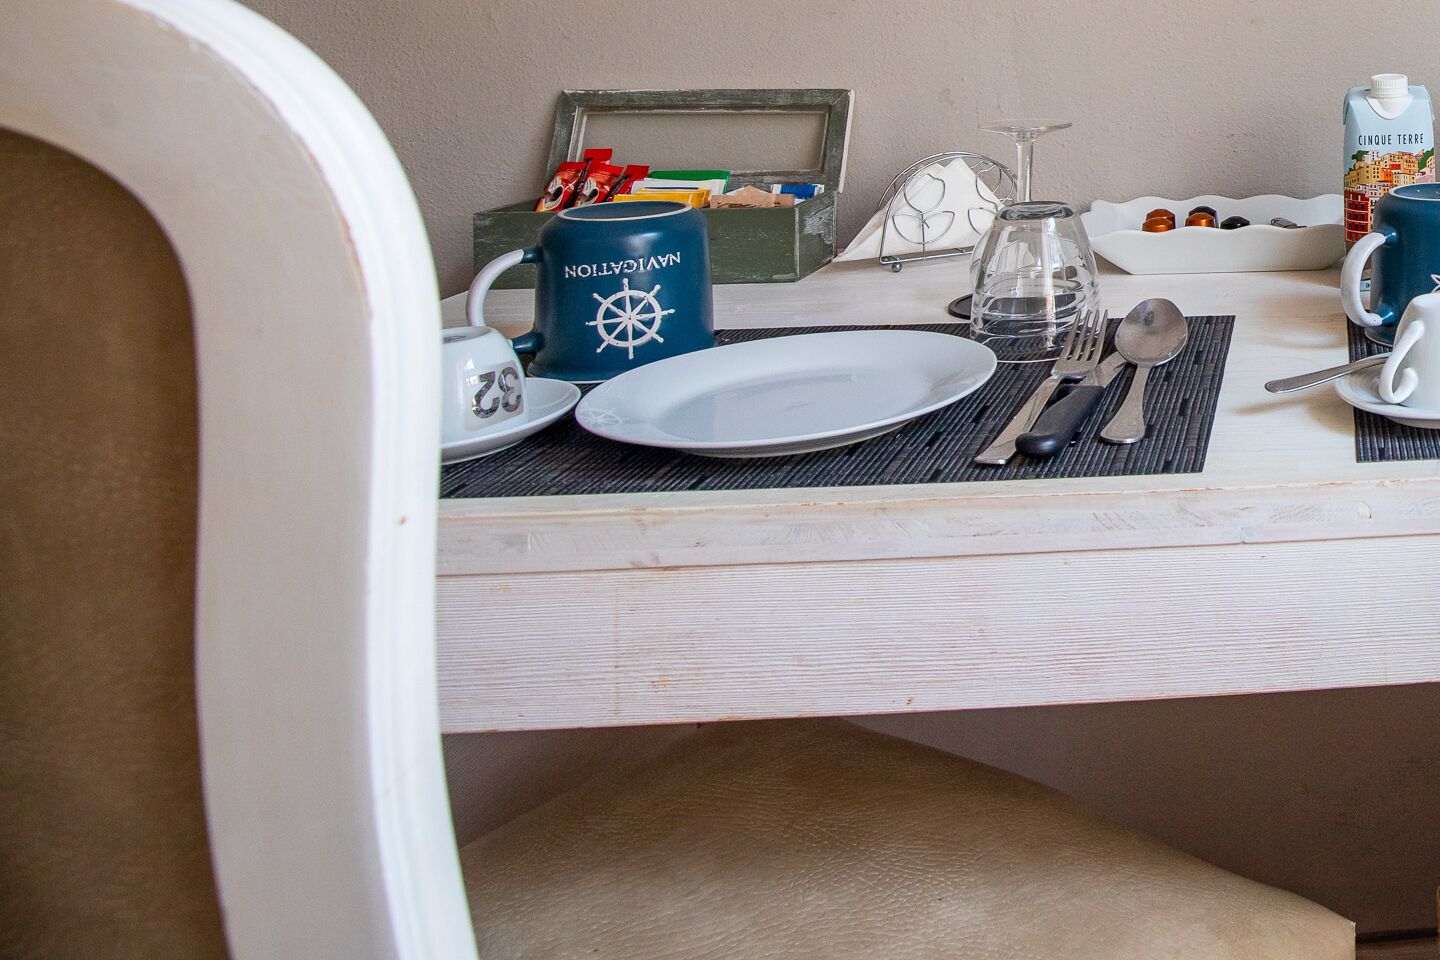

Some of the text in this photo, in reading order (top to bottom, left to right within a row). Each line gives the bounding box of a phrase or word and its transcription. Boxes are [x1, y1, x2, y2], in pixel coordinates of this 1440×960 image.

[1358, 133, 1424, 146] CINQUE TERRE
[564, 251, 681, 279] NAVIGATION
[469, 366, 522, 419] 32
